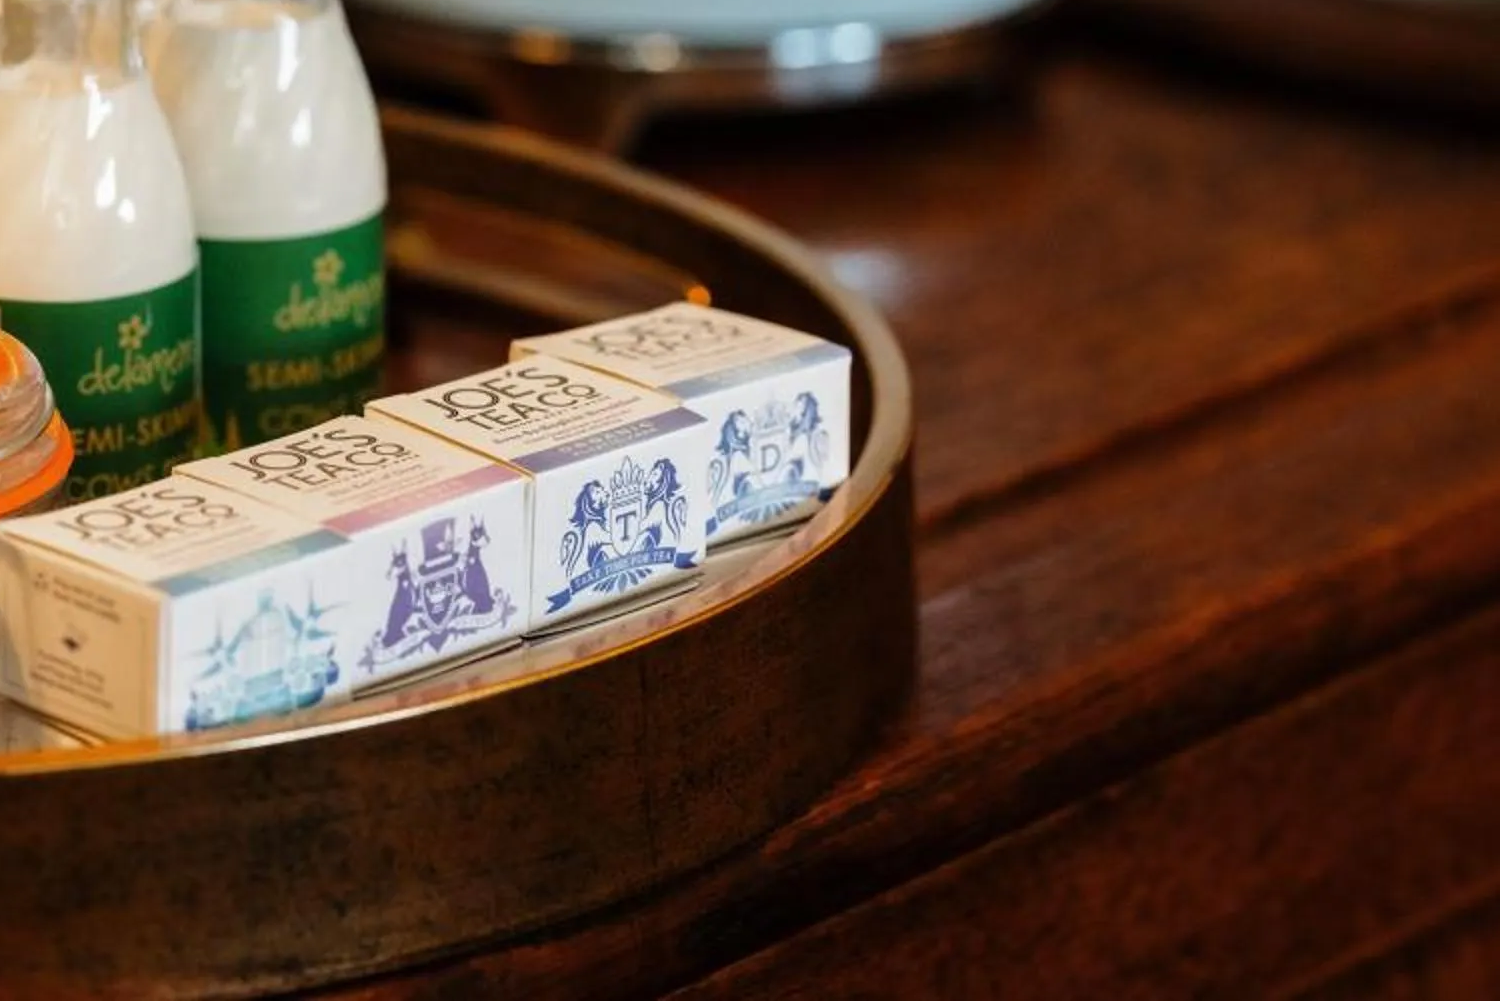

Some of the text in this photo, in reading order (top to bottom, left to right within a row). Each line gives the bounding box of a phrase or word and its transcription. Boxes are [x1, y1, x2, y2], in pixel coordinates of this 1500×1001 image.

[423, 366, 569, 419] JOE'S
[231, 429, 378, 480] JOE'S
[760, 444, 781, 473] D
[55, 488, 206, 540] JOE'S
[616, 510, 637, 541] T
